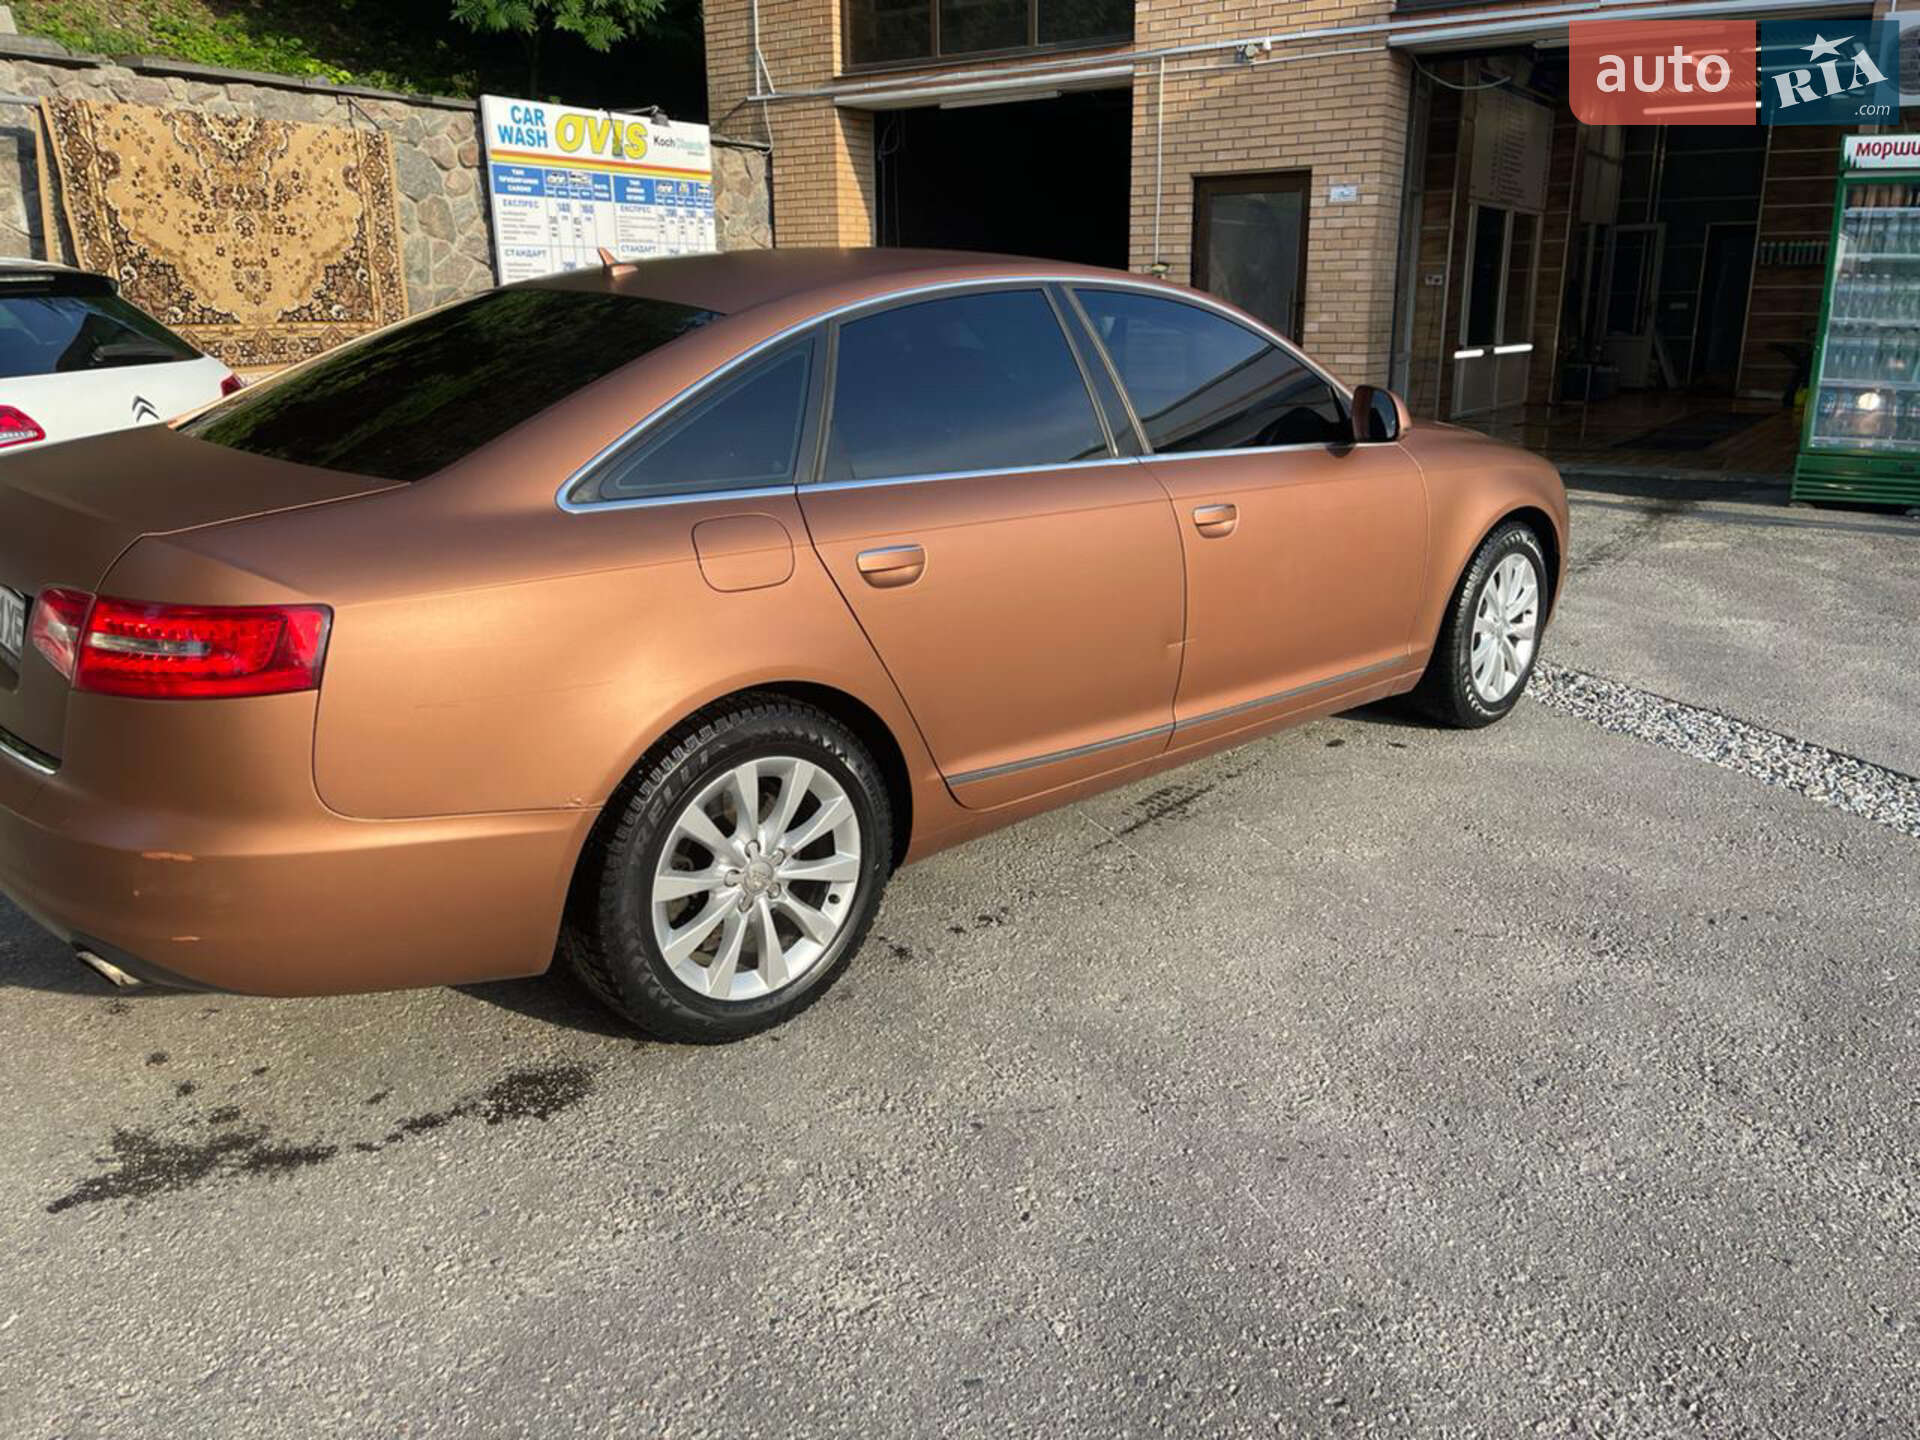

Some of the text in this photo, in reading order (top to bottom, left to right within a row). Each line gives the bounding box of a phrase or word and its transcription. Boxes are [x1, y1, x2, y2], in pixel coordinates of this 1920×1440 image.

[510, 105, 546, 127] CAR
[498, 125, 549, 148] WASH
[555, 112, 649, 159] OVIS
[502, 199, 540, 209] ЕКСПРЕС
[620, 205, 652, 214] ЕКСПРЕС
[504, 248, 547, 259] СТАНДАРТ
[620, 244, 657, 254] СТАНДАРТ
